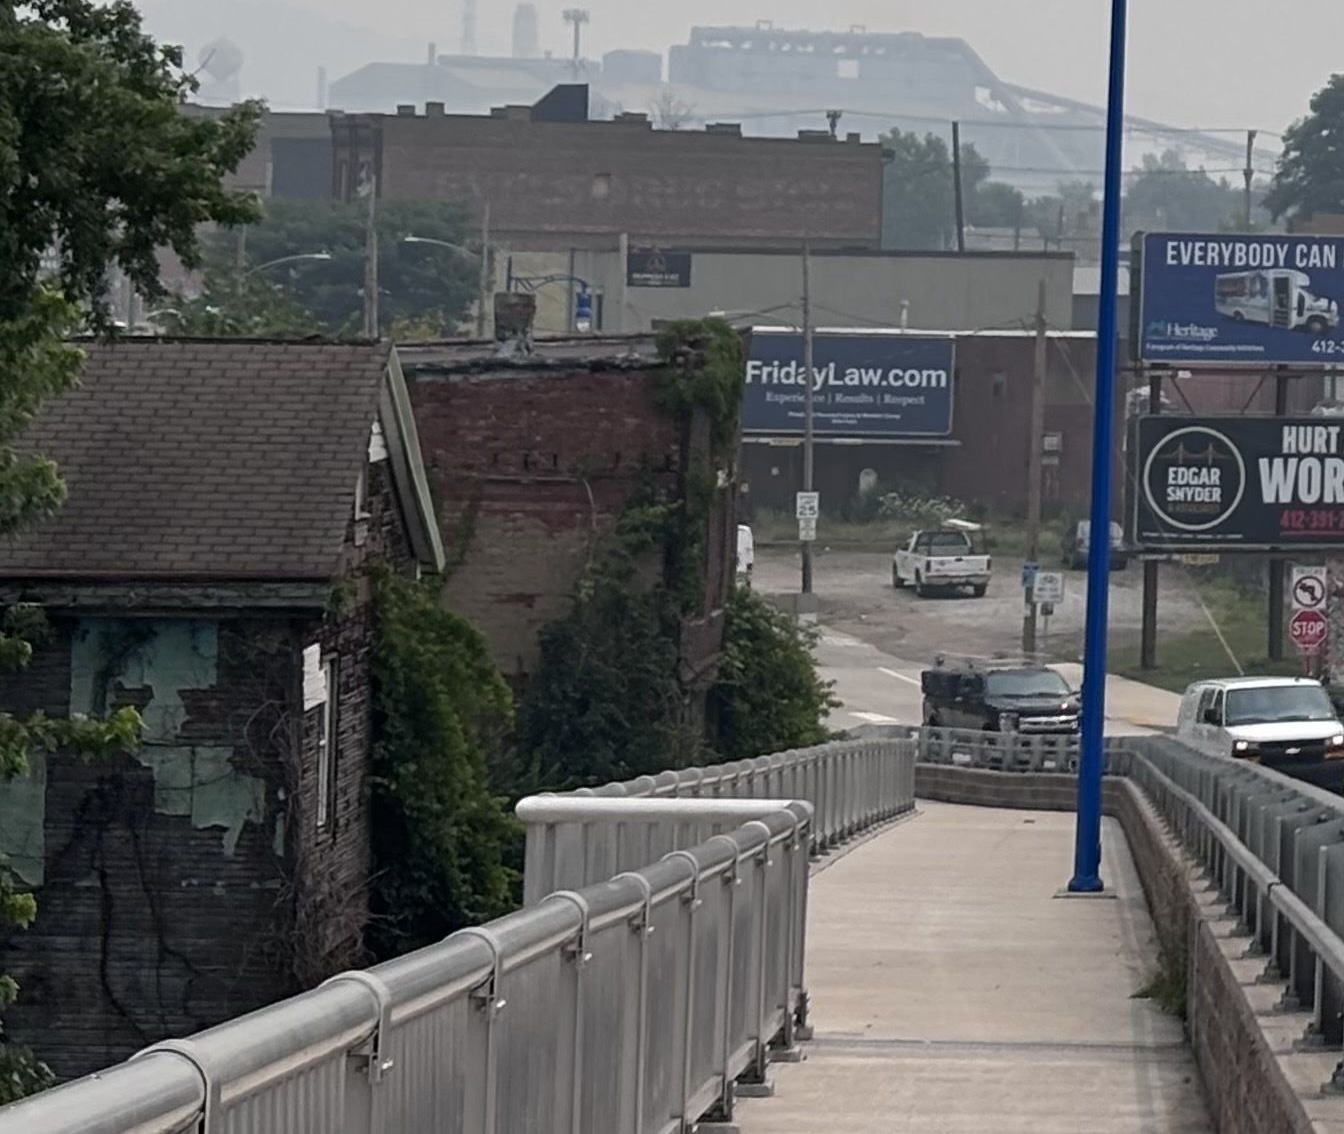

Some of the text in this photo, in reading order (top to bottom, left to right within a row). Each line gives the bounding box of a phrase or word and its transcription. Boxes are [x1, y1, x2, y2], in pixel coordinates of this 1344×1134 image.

[1166, 241, 1289, 267] EVERYBODY
[1295, 244, 1336, 268] CAN
[1167, 322, 1218, 341] Heritage
[746, 360, 947, 391] FridayLaw.com
[1282, 426, 1340, 454] HURT
[1167, 467, 1221, 485] EDGAR
[1166, 486, 1222, 502] SNYDER
[1293, 621, 1324, 636] STOP
